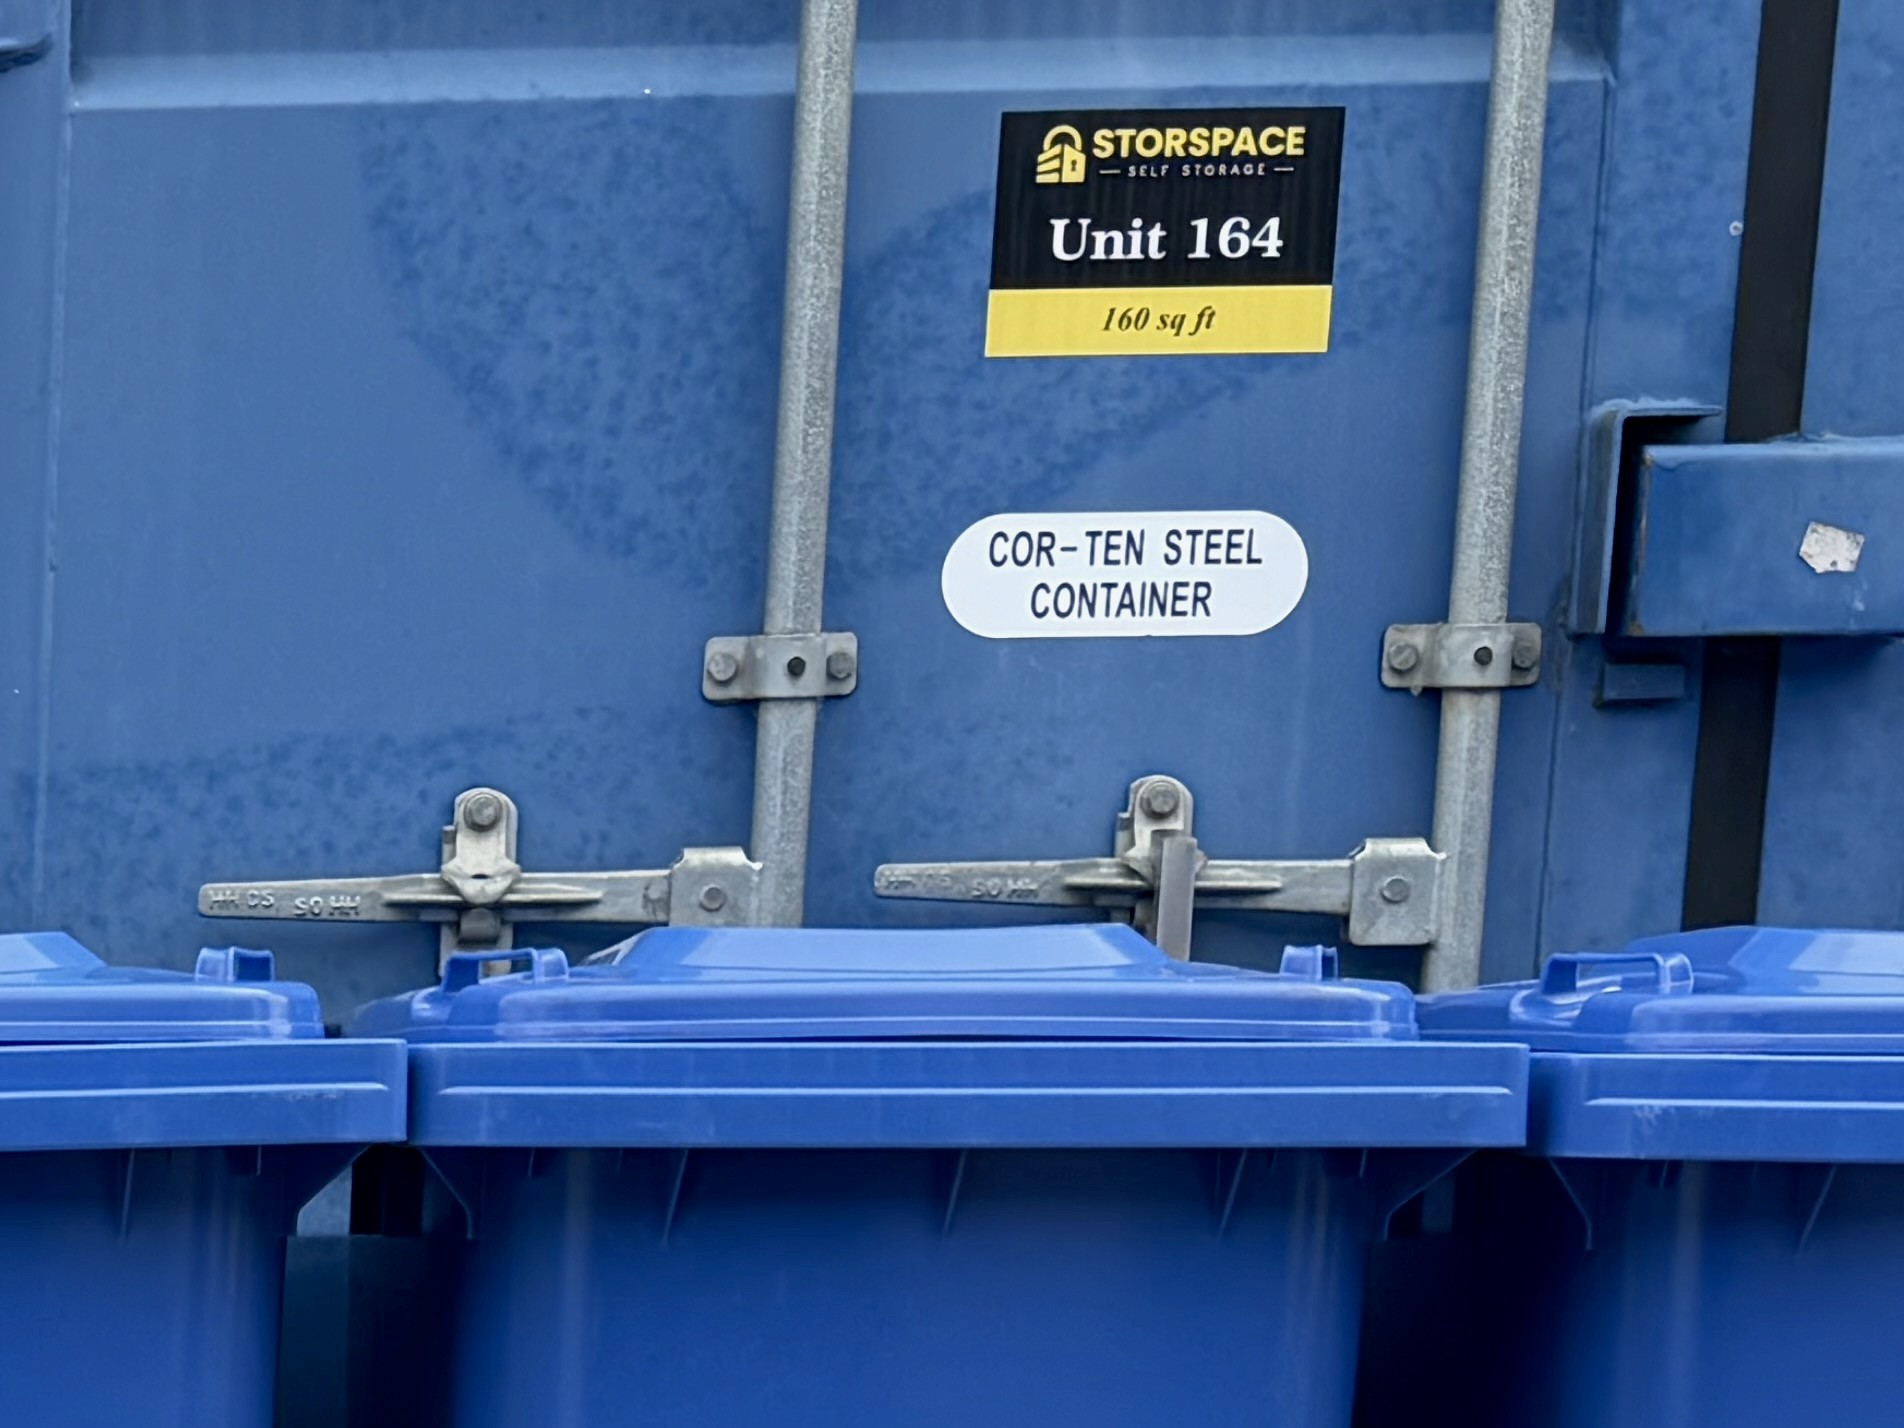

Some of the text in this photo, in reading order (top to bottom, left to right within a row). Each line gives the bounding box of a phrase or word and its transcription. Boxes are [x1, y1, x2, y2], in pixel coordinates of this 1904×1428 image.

[1091, 125, 1307, 160] STORSPACE
[1127, 163, 1267, 178] SELF STORAGE
[1048, 215, 1284, 262] Unit 164
[1100, 305, 1217, 338] 160 sq ft
[988, 527, 1263, 568] COR-TEN STEEL
[1030, 580, 1213, 619] CONTAINER
